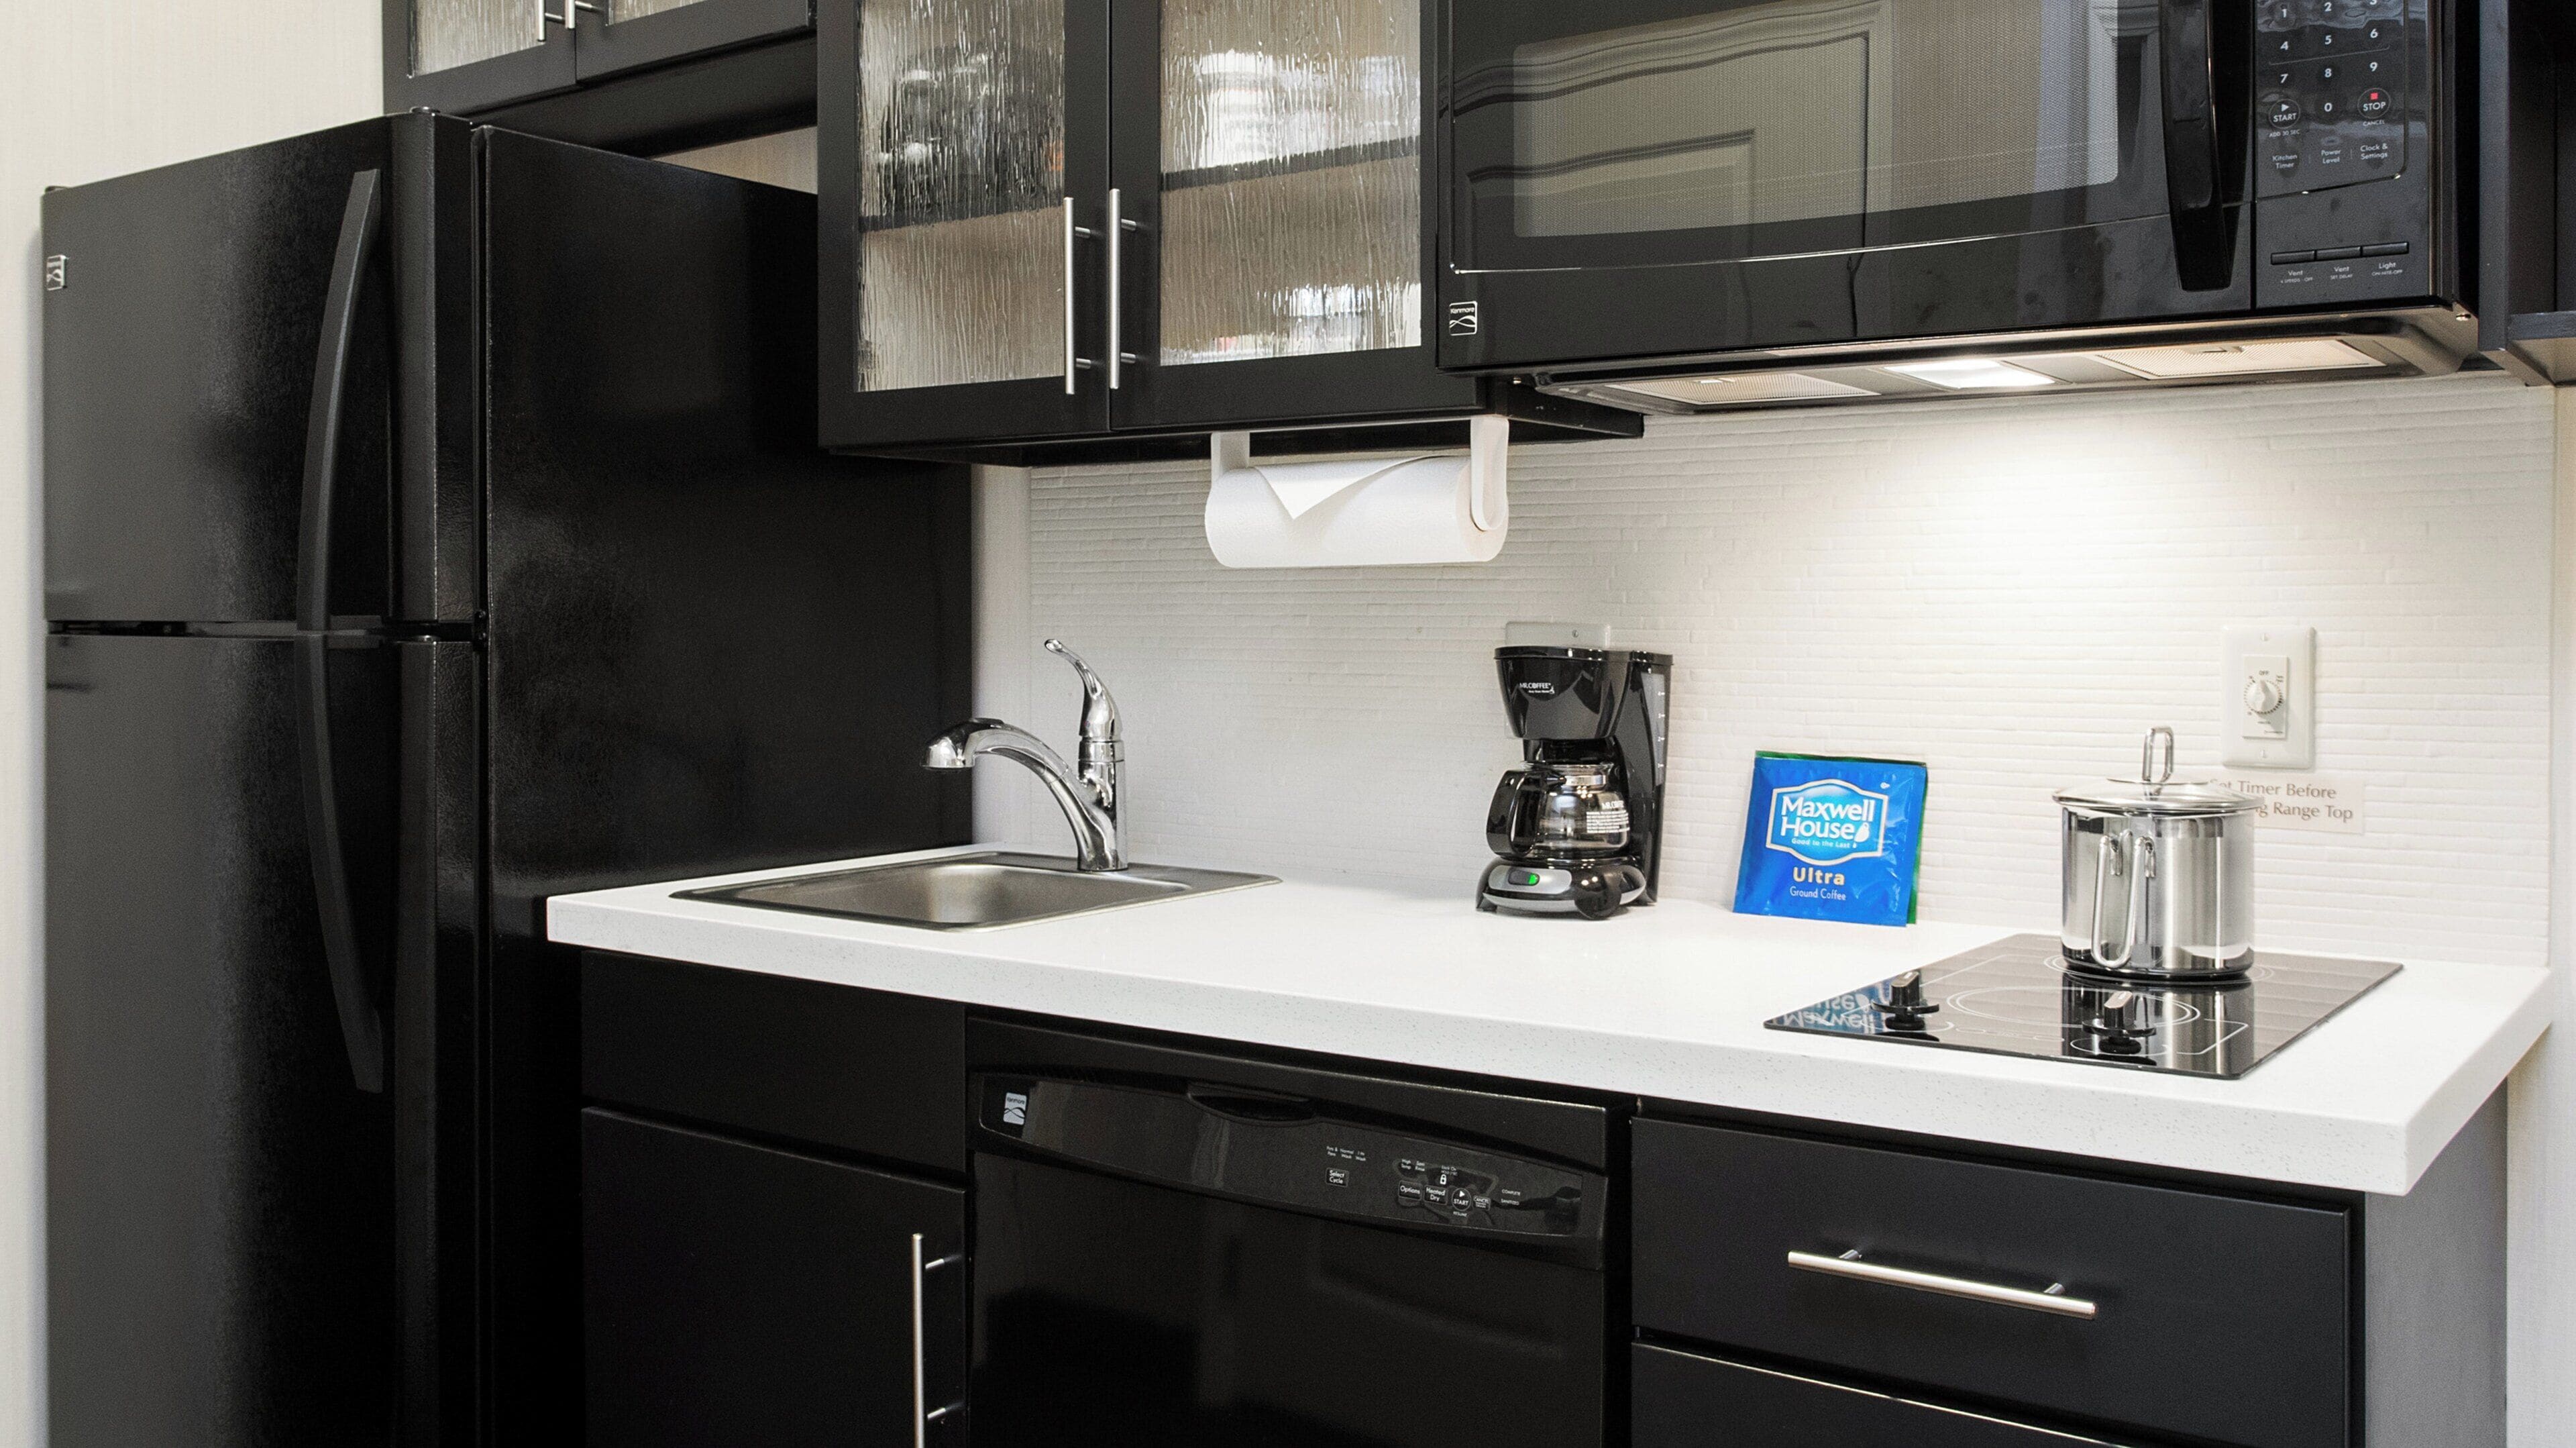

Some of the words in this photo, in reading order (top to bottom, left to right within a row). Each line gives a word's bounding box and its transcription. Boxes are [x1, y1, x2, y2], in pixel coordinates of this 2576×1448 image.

[2282, 8, 2288, 17] 1
[2324, 2, 2332, 11] 2
[2280, 41, 2289, 50] 4
[2324, 35, 2332, 45] 5
[2370, 28, 2378, 38] 6
[2281, 74, 2288, 83] 7
[2324, 68, 2332, 78] 8
[2369, 62, 2377, 72] 9
[2324, 103, 2332, 112] 0
[2363, 101, 2386, 111] STOP
[2273, 113, 2297, 123] START
[2360, 145, 2380, 153] Clock
[2361, 152, 2388, 160] Settings
[2238, 780, 2281, 796] Timer
[2286, 783, 2337, 799] Before
[1781, 796, 1876, 822] Maxwell
[2273, 801, 2320, 821] Range
[2324, 805, 2353, 823] Top
[1780, 815, 1856, 840] House
[1791, 837, 1810, 845] Good
[1792, 866, 1845, 886] Ultra
[1789, 885, 1819, 898] Ground
[1820, 888, 1847, 900] Coffee
[1330, 1170, 1345, 1178] Select
[1329, 1176, 1344, 1184] Cycle
[1400, 1185, 1421, 1195] Options
[1426, 1187, 1446, 1196] Heated
[1453, 1198, 1469, 1206] START
[1473, 1196, 1490, 1204] CANCEL
